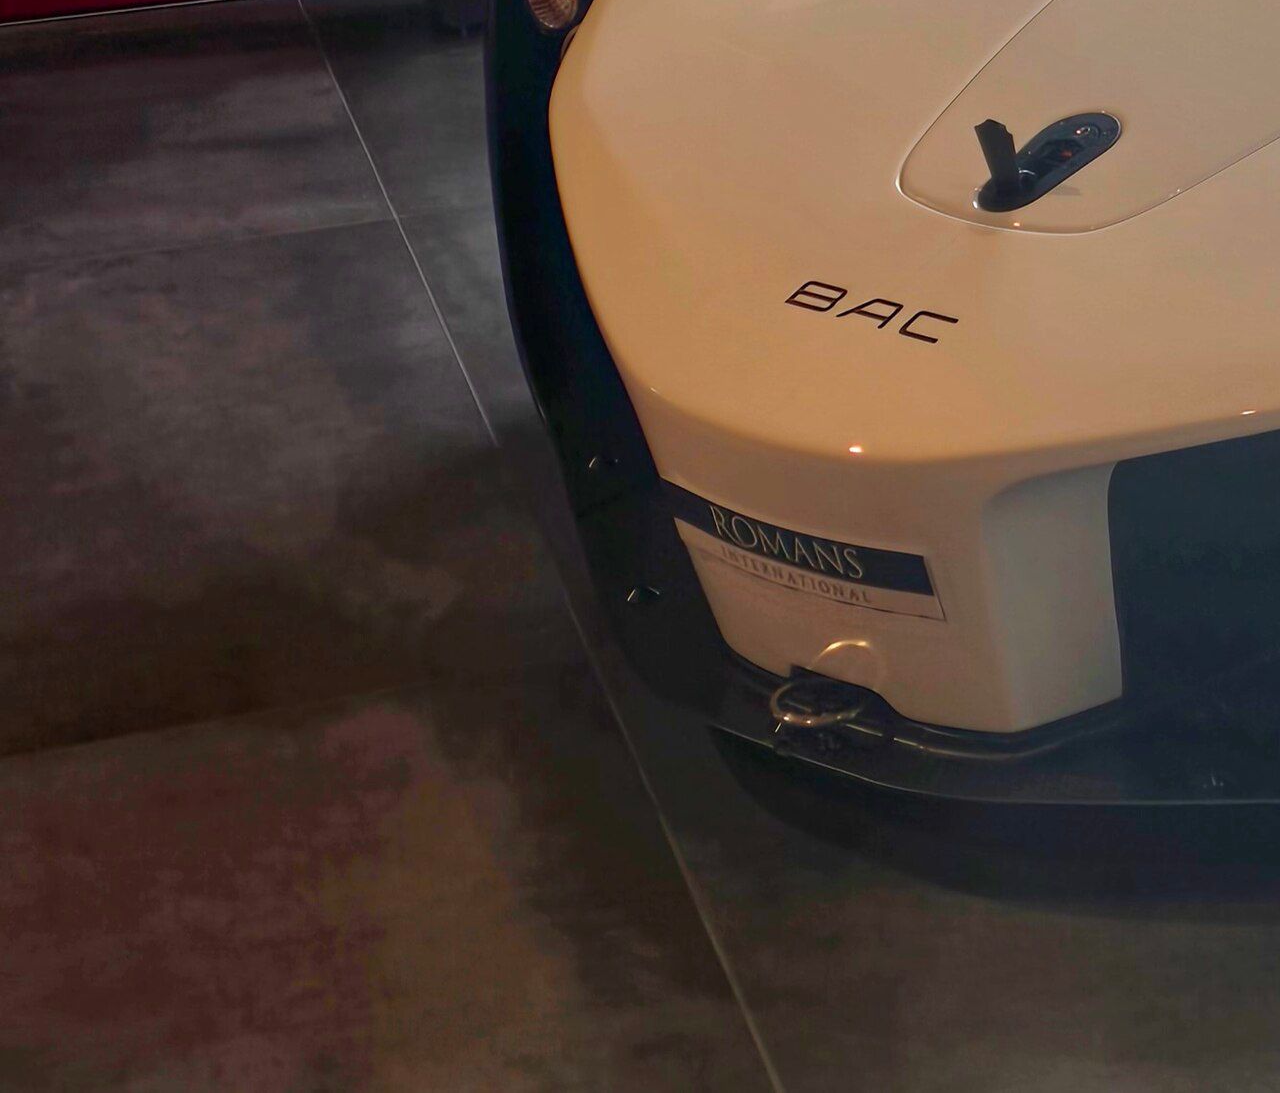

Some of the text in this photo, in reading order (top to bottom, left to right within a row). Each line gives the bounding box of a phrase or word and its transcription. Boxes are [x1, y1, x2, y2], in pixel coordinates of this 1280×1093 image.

[784, 280, 960, 344] BAC
[709, 504, 864, 579] ROMANS
[721, 544, 873, 604] INTERNATIONAL
